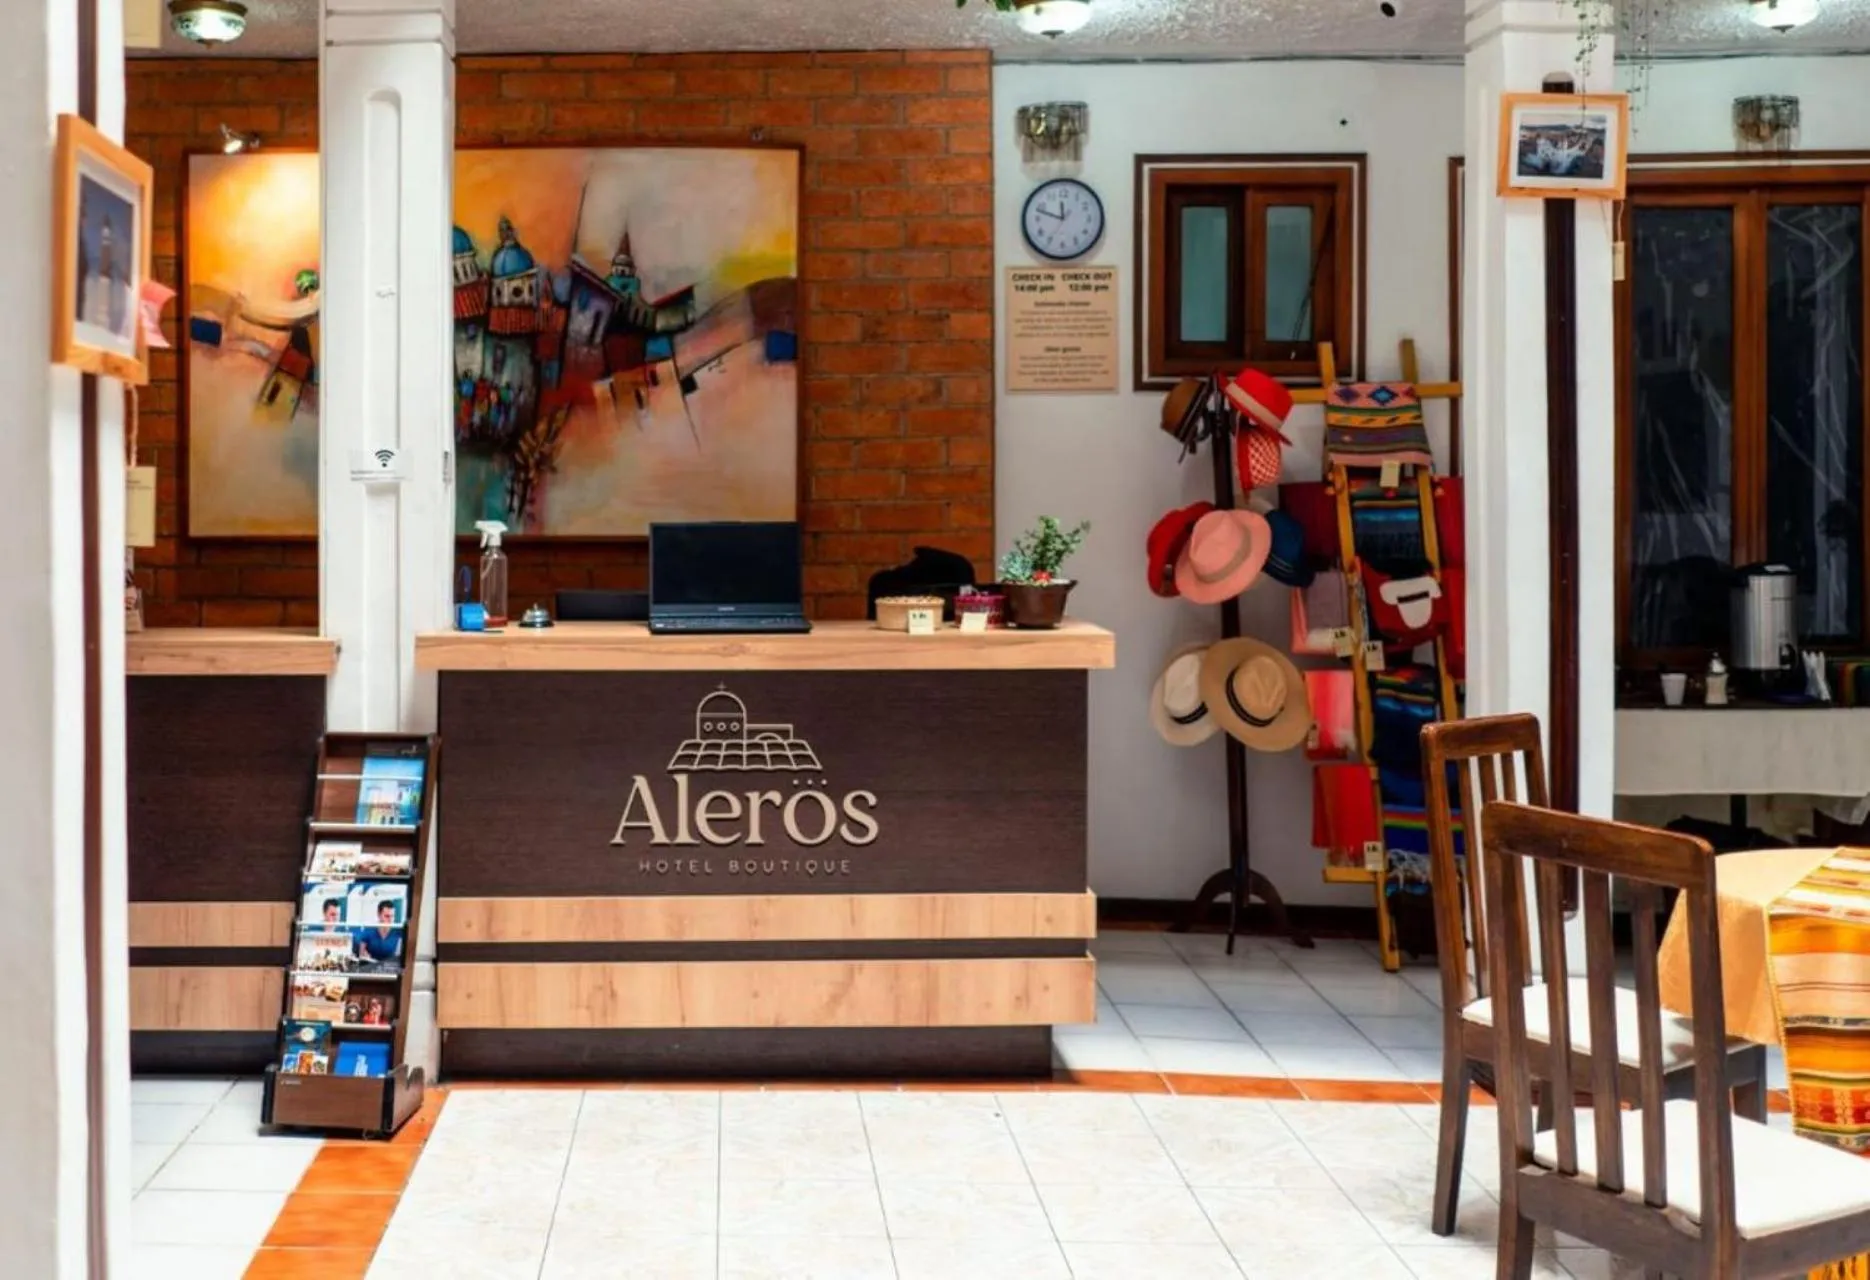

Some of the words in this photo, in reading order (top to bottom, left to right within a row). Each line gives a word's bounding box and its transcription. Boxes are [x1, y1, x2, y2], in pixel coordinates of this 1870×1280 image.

[1012, 273, 1041, 281] CHECK
[1043, 272, 1055, 281] IN
[1061, 272, 1090, 281] CHECK
[1093, 272, 1112, 281] OUT
[639, 859, 713, 874] HOTEL
[728, 859, 851, 875] BOUTIQUE
